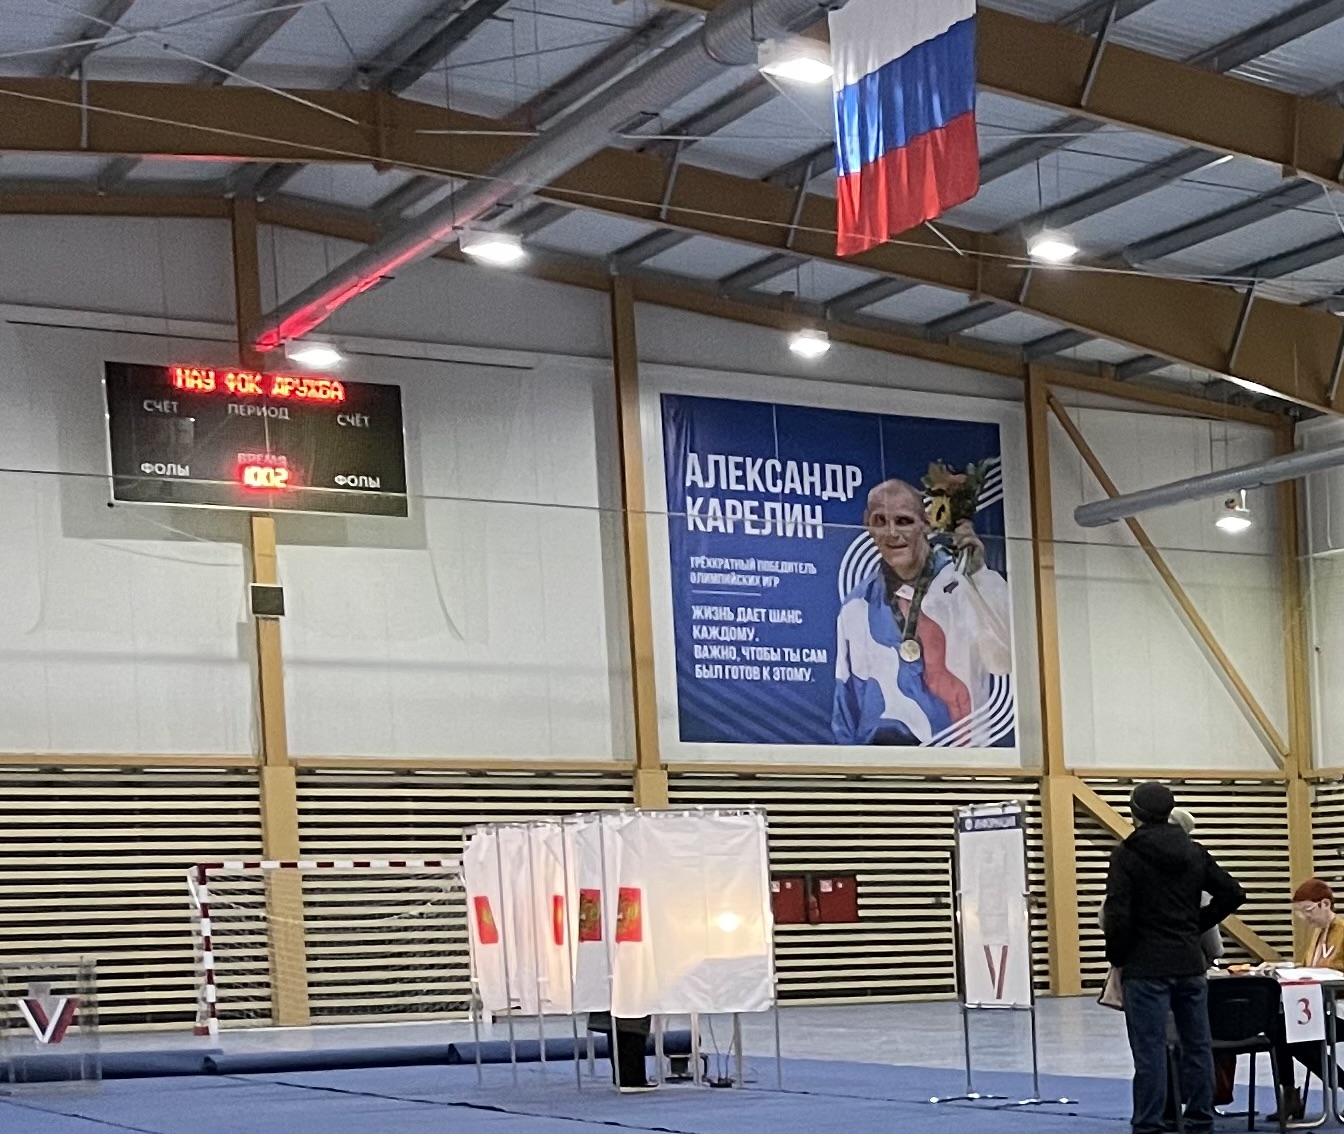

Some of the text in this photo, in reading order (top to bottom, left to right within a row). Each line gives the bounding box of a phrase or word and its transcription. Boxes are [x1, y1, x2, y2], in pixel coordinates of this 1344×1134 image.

[228, 403, 290, 420] ПЕРИОД
[140, 461, 190, 477] ФОЛЫ
[685, 452, 863, 502] АЛЕКСАНДР
[334, 474, 381, 489] ФОЛЫ
[686, 496, 824, 540] КАРЕЛИН
[757, 559, 817, 574] ПОБЕДИТЕЛЬ
[762, 576, 780, 587] ИГР
[692, 605, 735, 621] ЖИЗНЬ
[768, 609, 803, 624] ШАНС
[692, 625, 760, 642] КАЖДОМУ.
[693, 645, 827, 663] ВАЖНО, ЧТОБЫ ТЫ САМ
[695, 665, 723, 679] БЫЛ
[724, 665, 761, 680] ГОТОВ
[762, 666, 771, 681] К
[1297, 997, 1312, 1026] 3
